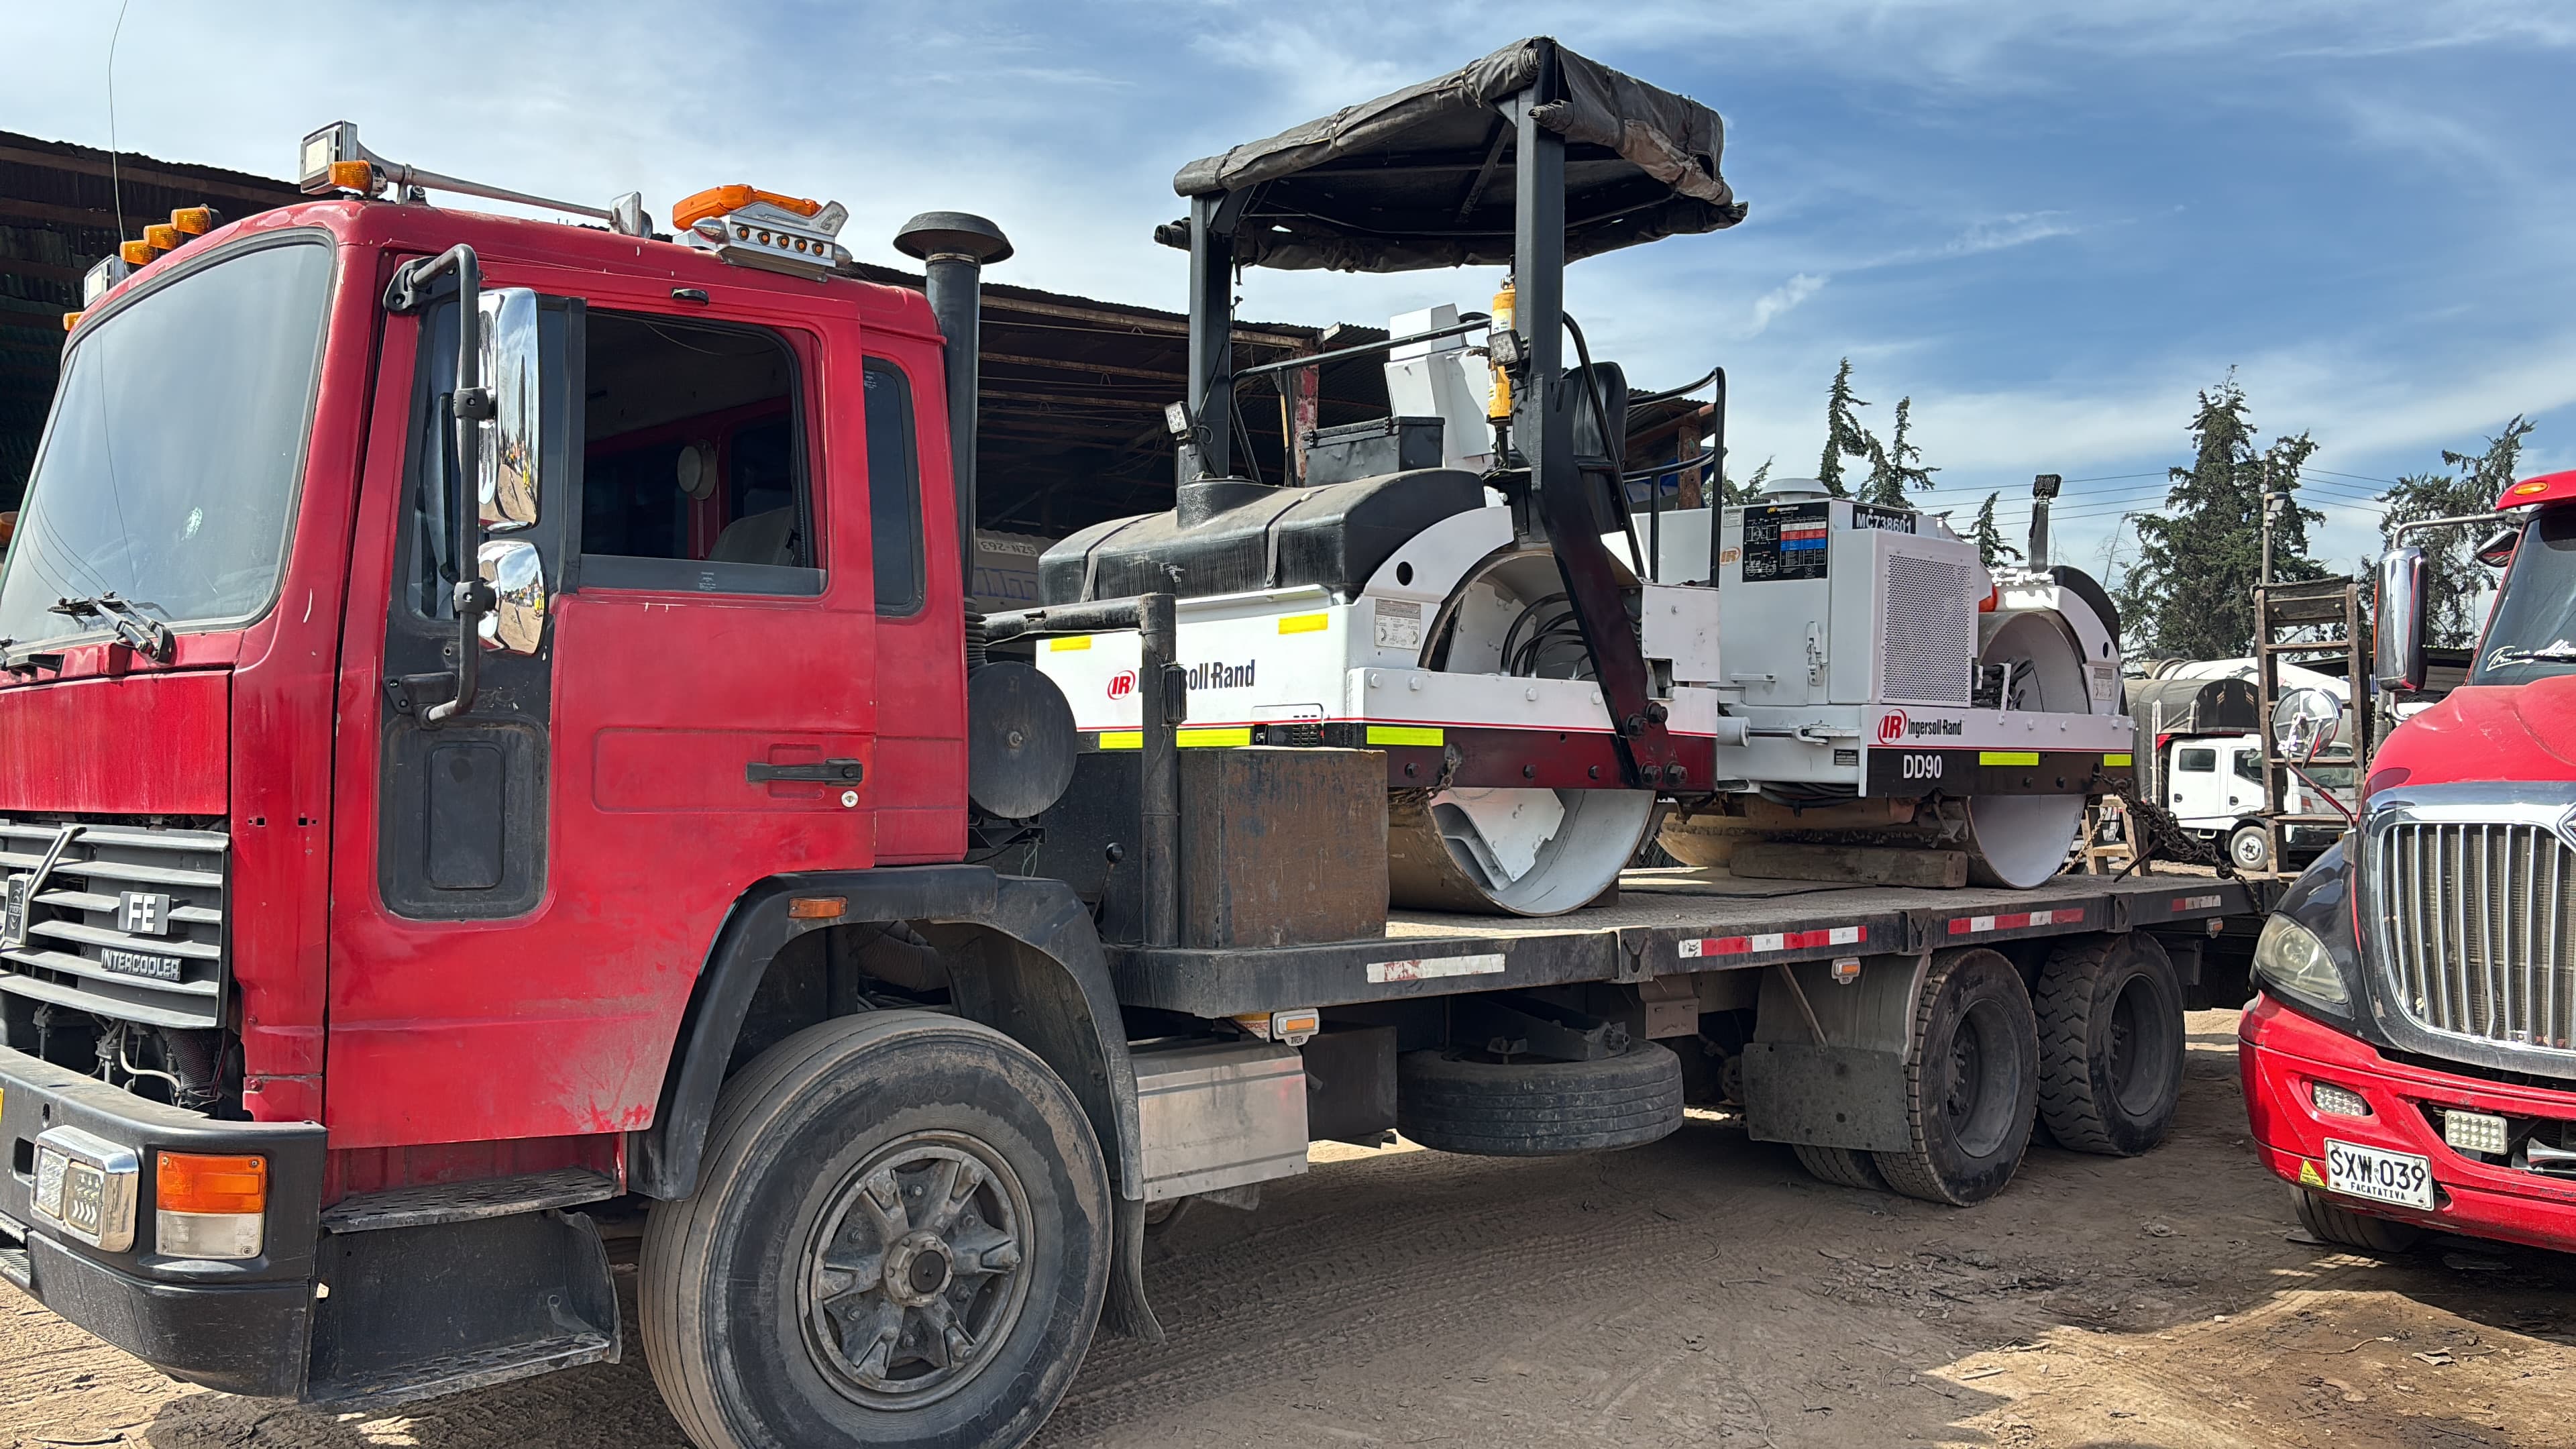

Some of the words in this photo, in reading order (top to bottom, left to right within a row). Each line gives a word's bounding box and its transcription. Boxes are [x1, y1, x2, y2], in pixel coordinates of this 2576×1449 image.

[1857, 513, 1911, 533] MC738601
[1903, 755, 1942, 778] DD90
[127, 894, 156, 932] FE
[101, 948, 181, 981] INTERCOOLER
[2379, 1159, 2426, 1192] 039
[2351, 1181, 2406, 1201] FACATATIVA
